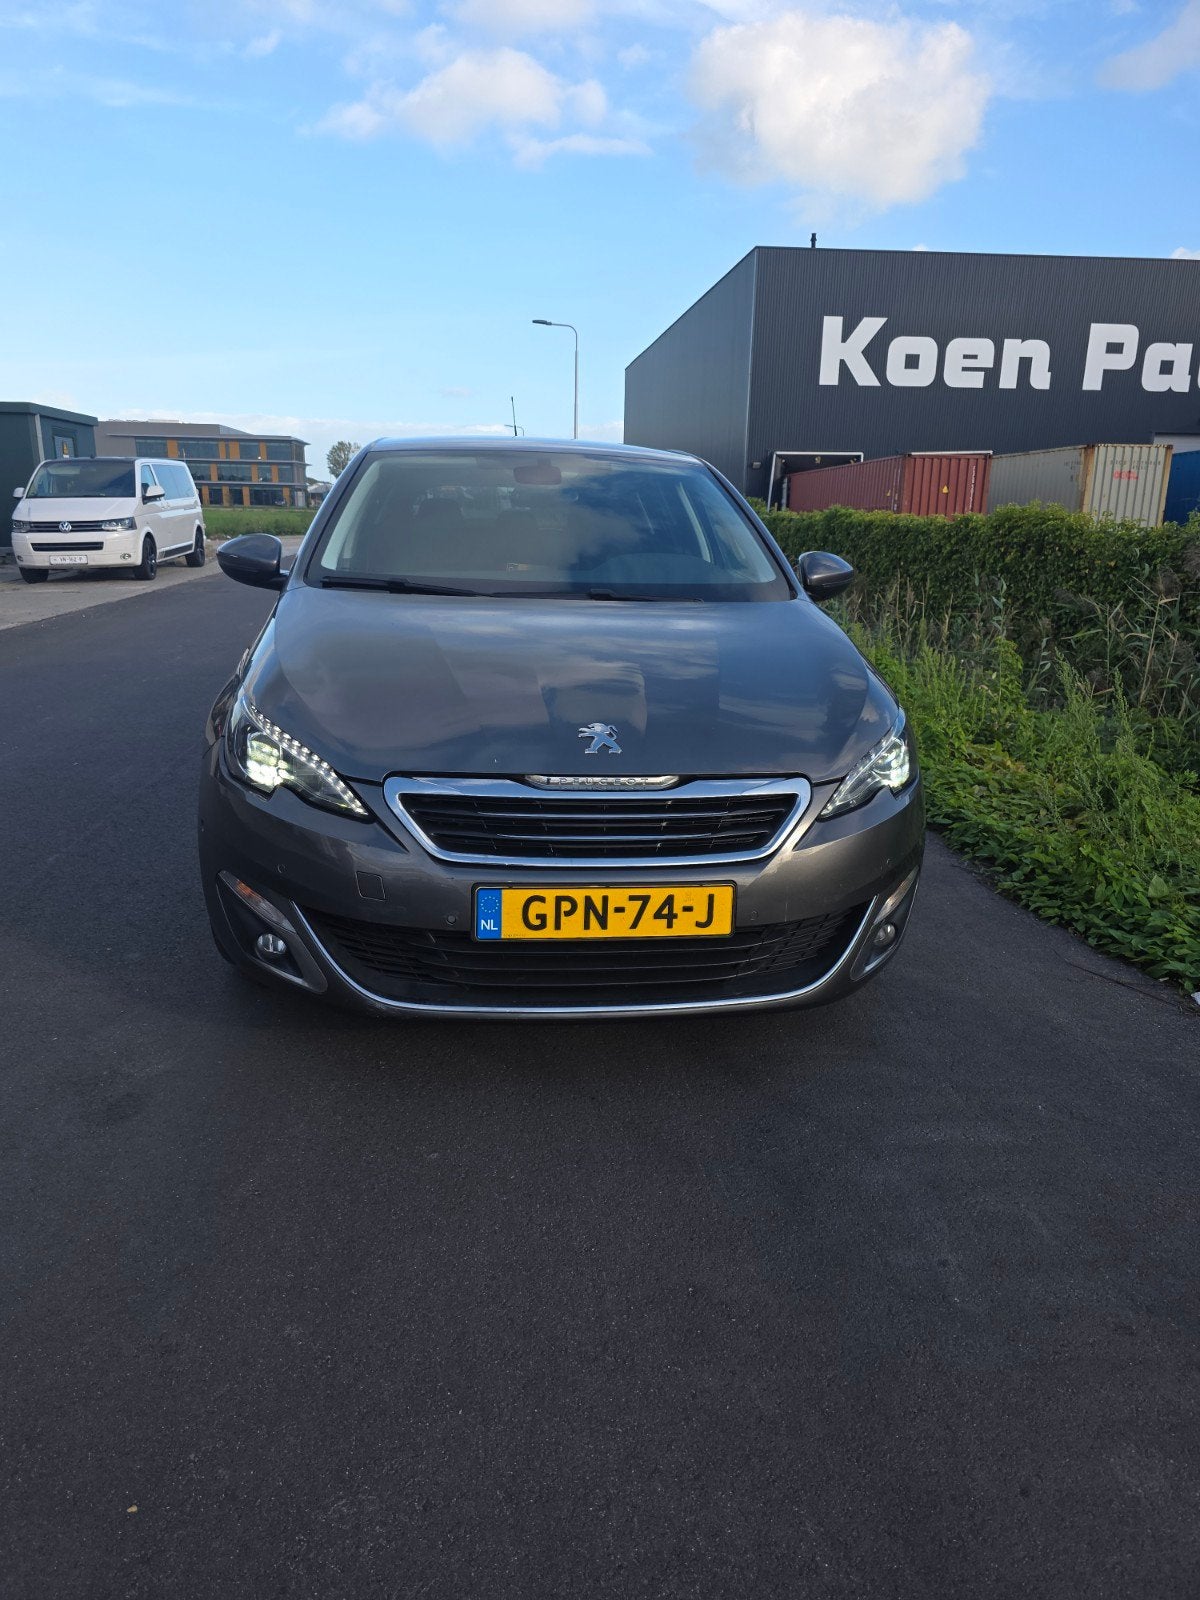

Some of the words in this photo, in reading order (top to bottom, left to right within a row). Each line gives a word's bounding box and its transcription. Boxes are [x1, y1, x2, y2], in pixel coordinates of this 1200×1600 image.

[819, 315, 1051, 390] Koen
[1082, 322, 1200, 393] Pa
[559, 777, 649, 786] PEUGEOT
[521, 893, 715, 931] GPN-74-J
[480, 919, 498, 931] NL
